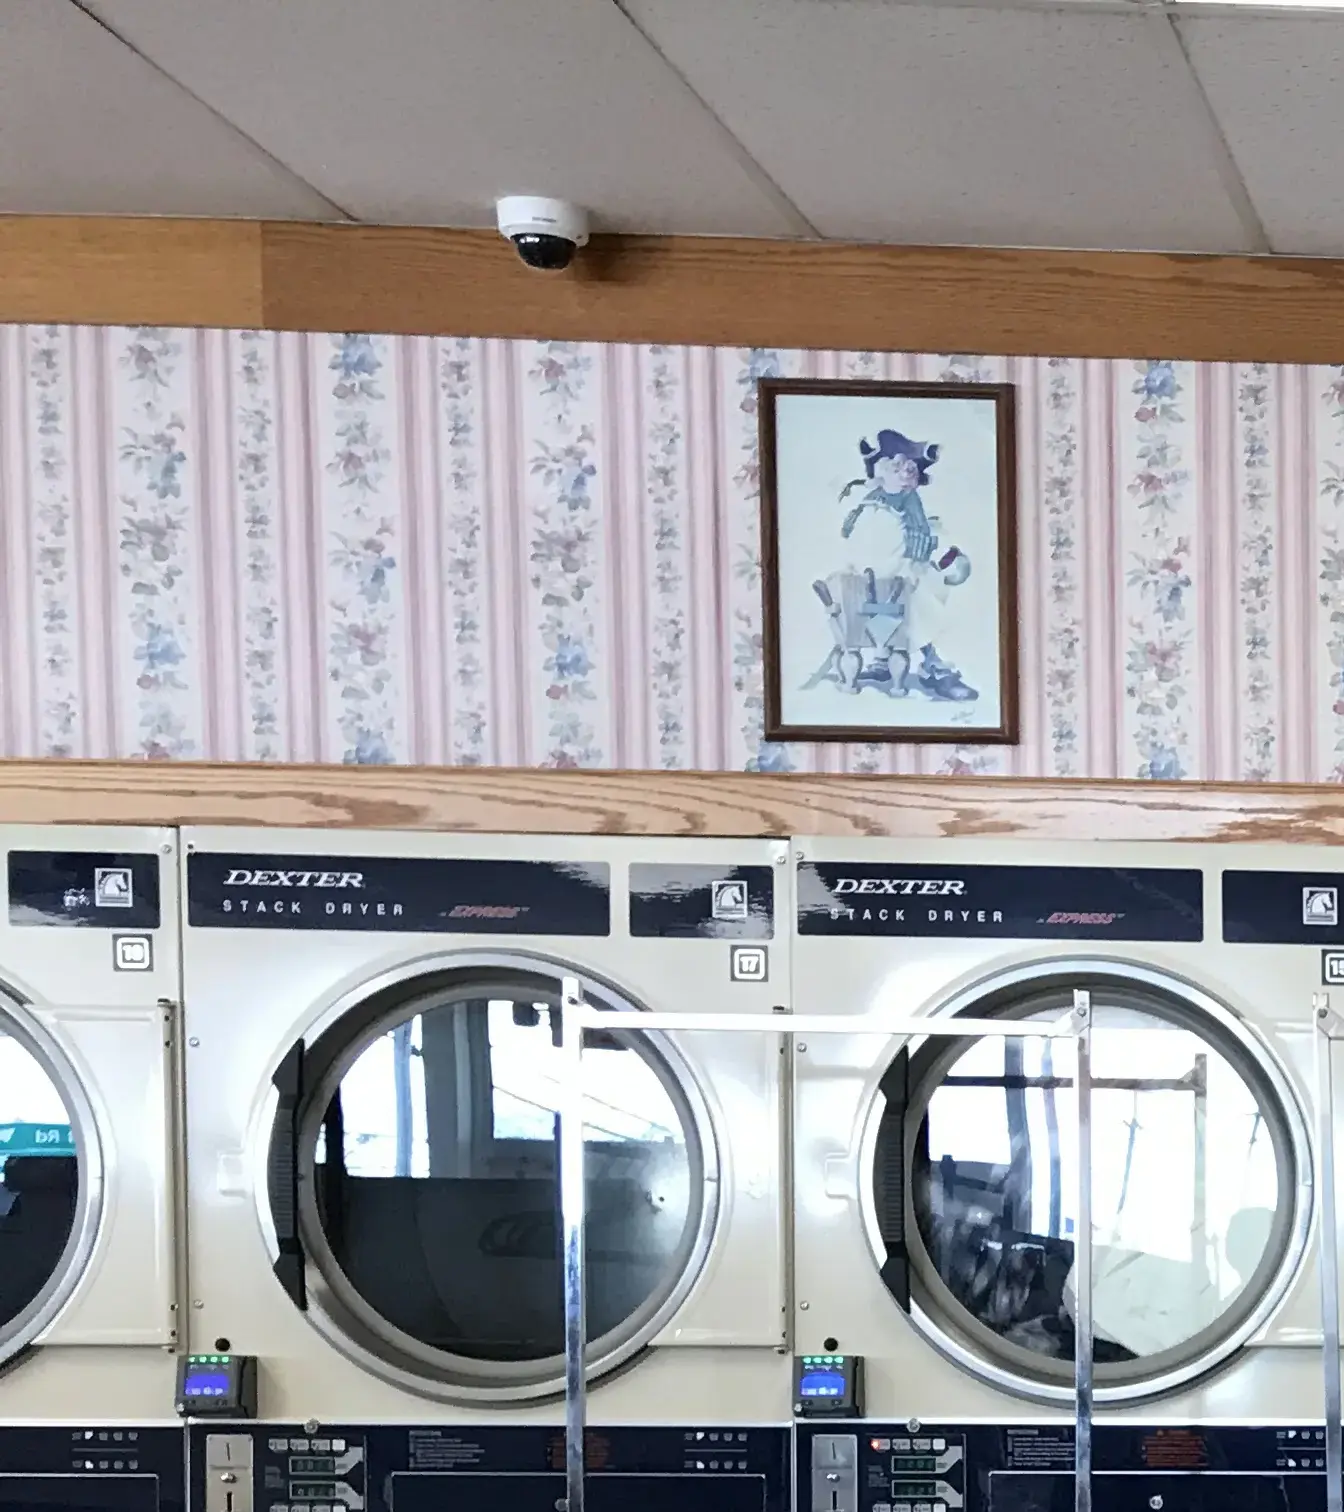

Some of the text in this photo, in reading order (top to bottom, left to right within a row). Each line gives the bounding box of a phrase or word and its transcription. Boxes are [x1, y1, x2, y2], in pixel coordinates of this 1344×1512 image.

[223, 869, 364, 888] DEXTER
[834, 878, 966, 896] DEXTER
[223, 899, 403, 916] STACK DRYER
[829, 907, 1003, 923] STACK DRYER
[739, 956, 759, 973] 17
